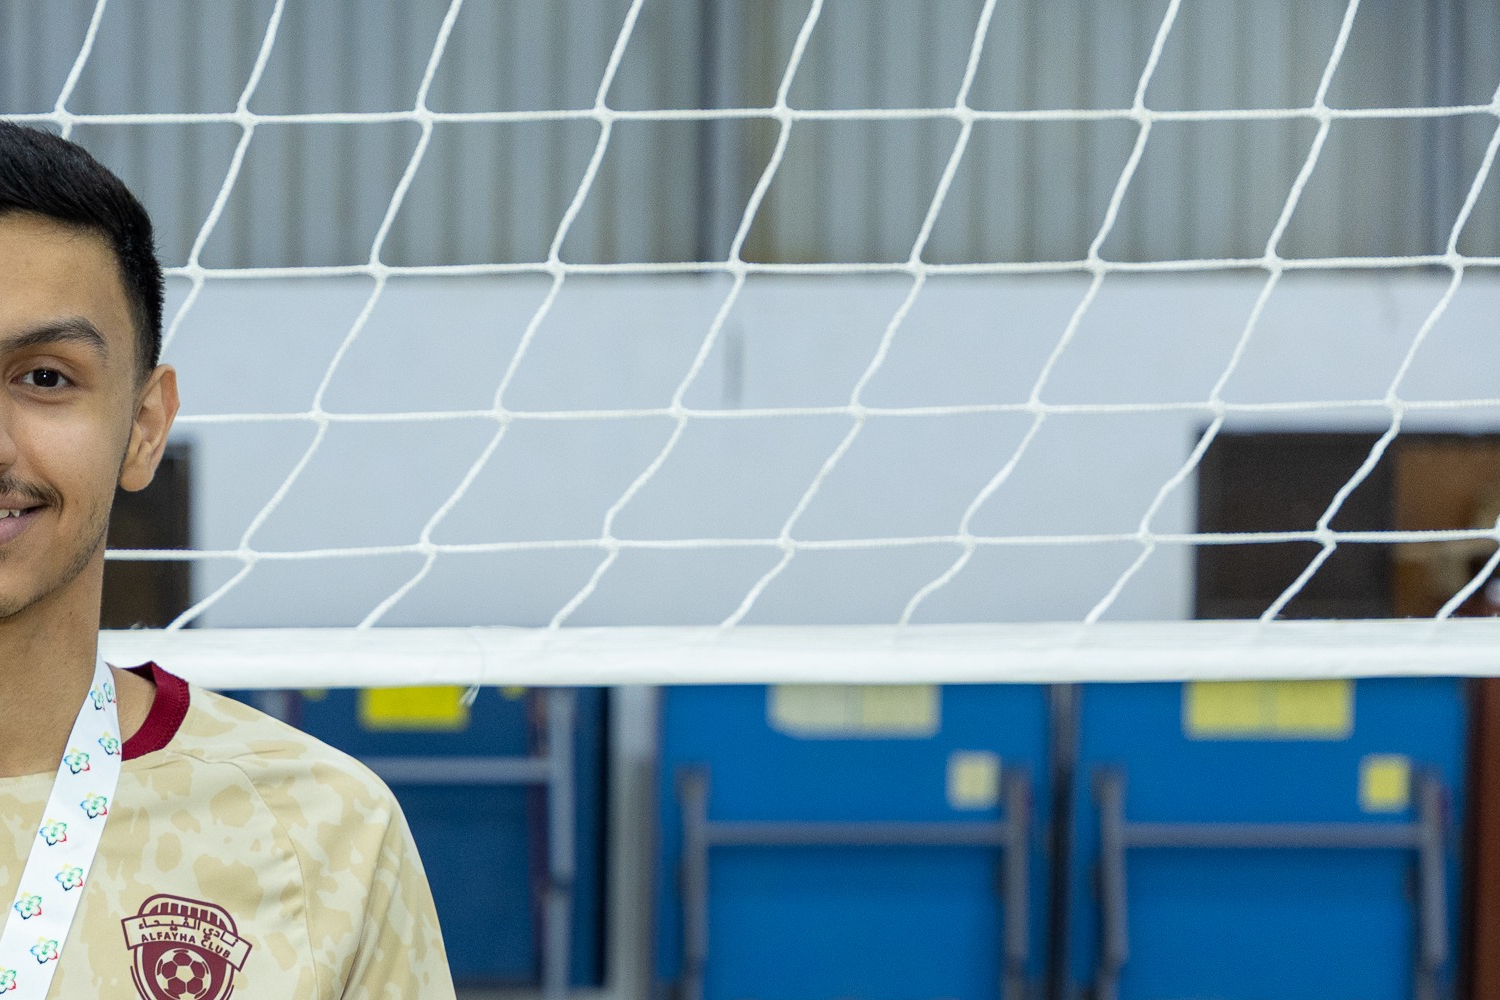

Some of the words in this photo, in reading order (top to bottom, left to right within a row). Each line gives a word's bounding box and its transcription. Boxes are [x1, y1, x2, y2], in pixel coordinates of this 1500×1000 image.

[139, 916, 200, 932] الفيحاء
[141, 931, 196, 944] ALFAYHA
[201, 940, 231, 958] CLUB
[203, 928, 239, 948] نادي
